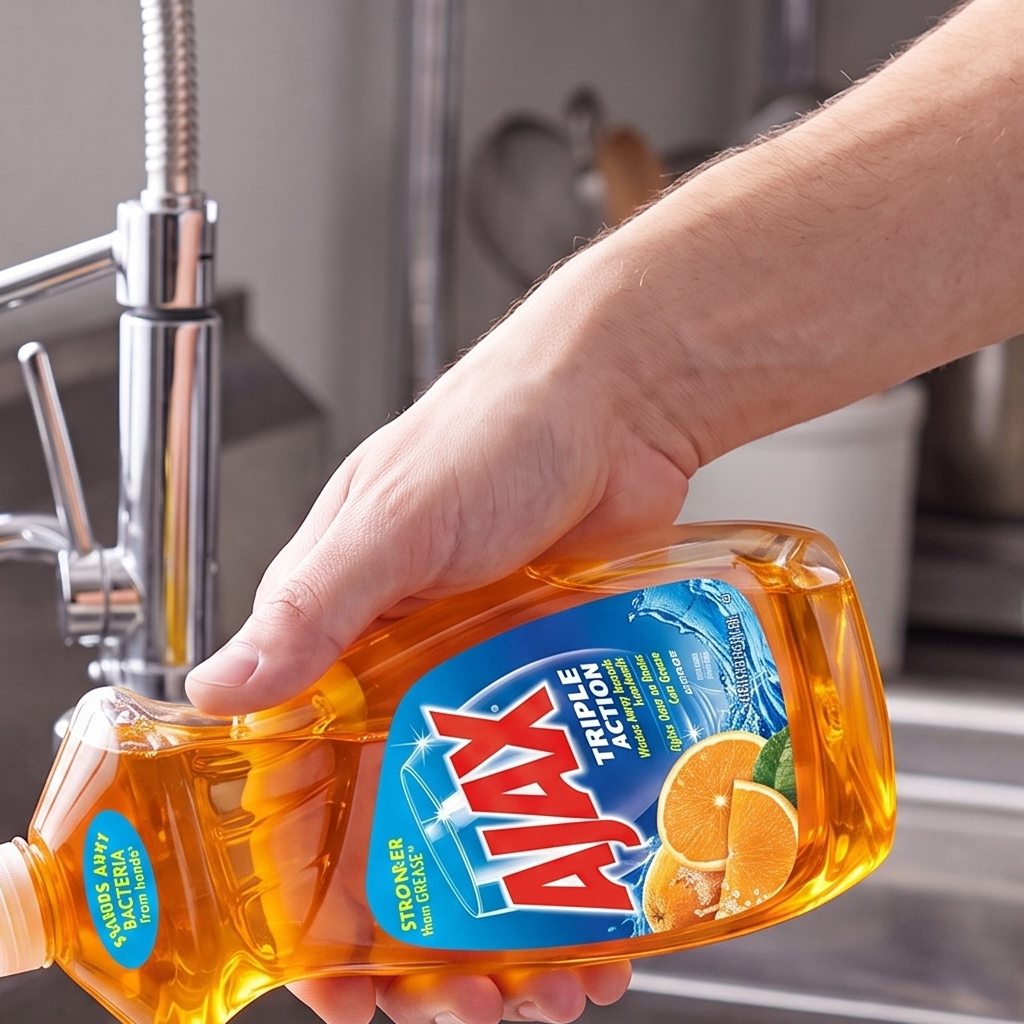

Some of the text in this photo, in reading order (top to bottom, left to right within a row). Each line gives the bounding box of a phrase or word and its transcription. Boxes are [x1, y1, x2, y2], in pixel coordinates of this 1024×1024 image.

[556, 667, 615, 766] TRIPLE
[579, 662, 632, 750] ACTION
[426, 684, 643, 913] AJAX
[110, 849, 138, 930] BACTERIA
[139, 893, 151, 923] from
